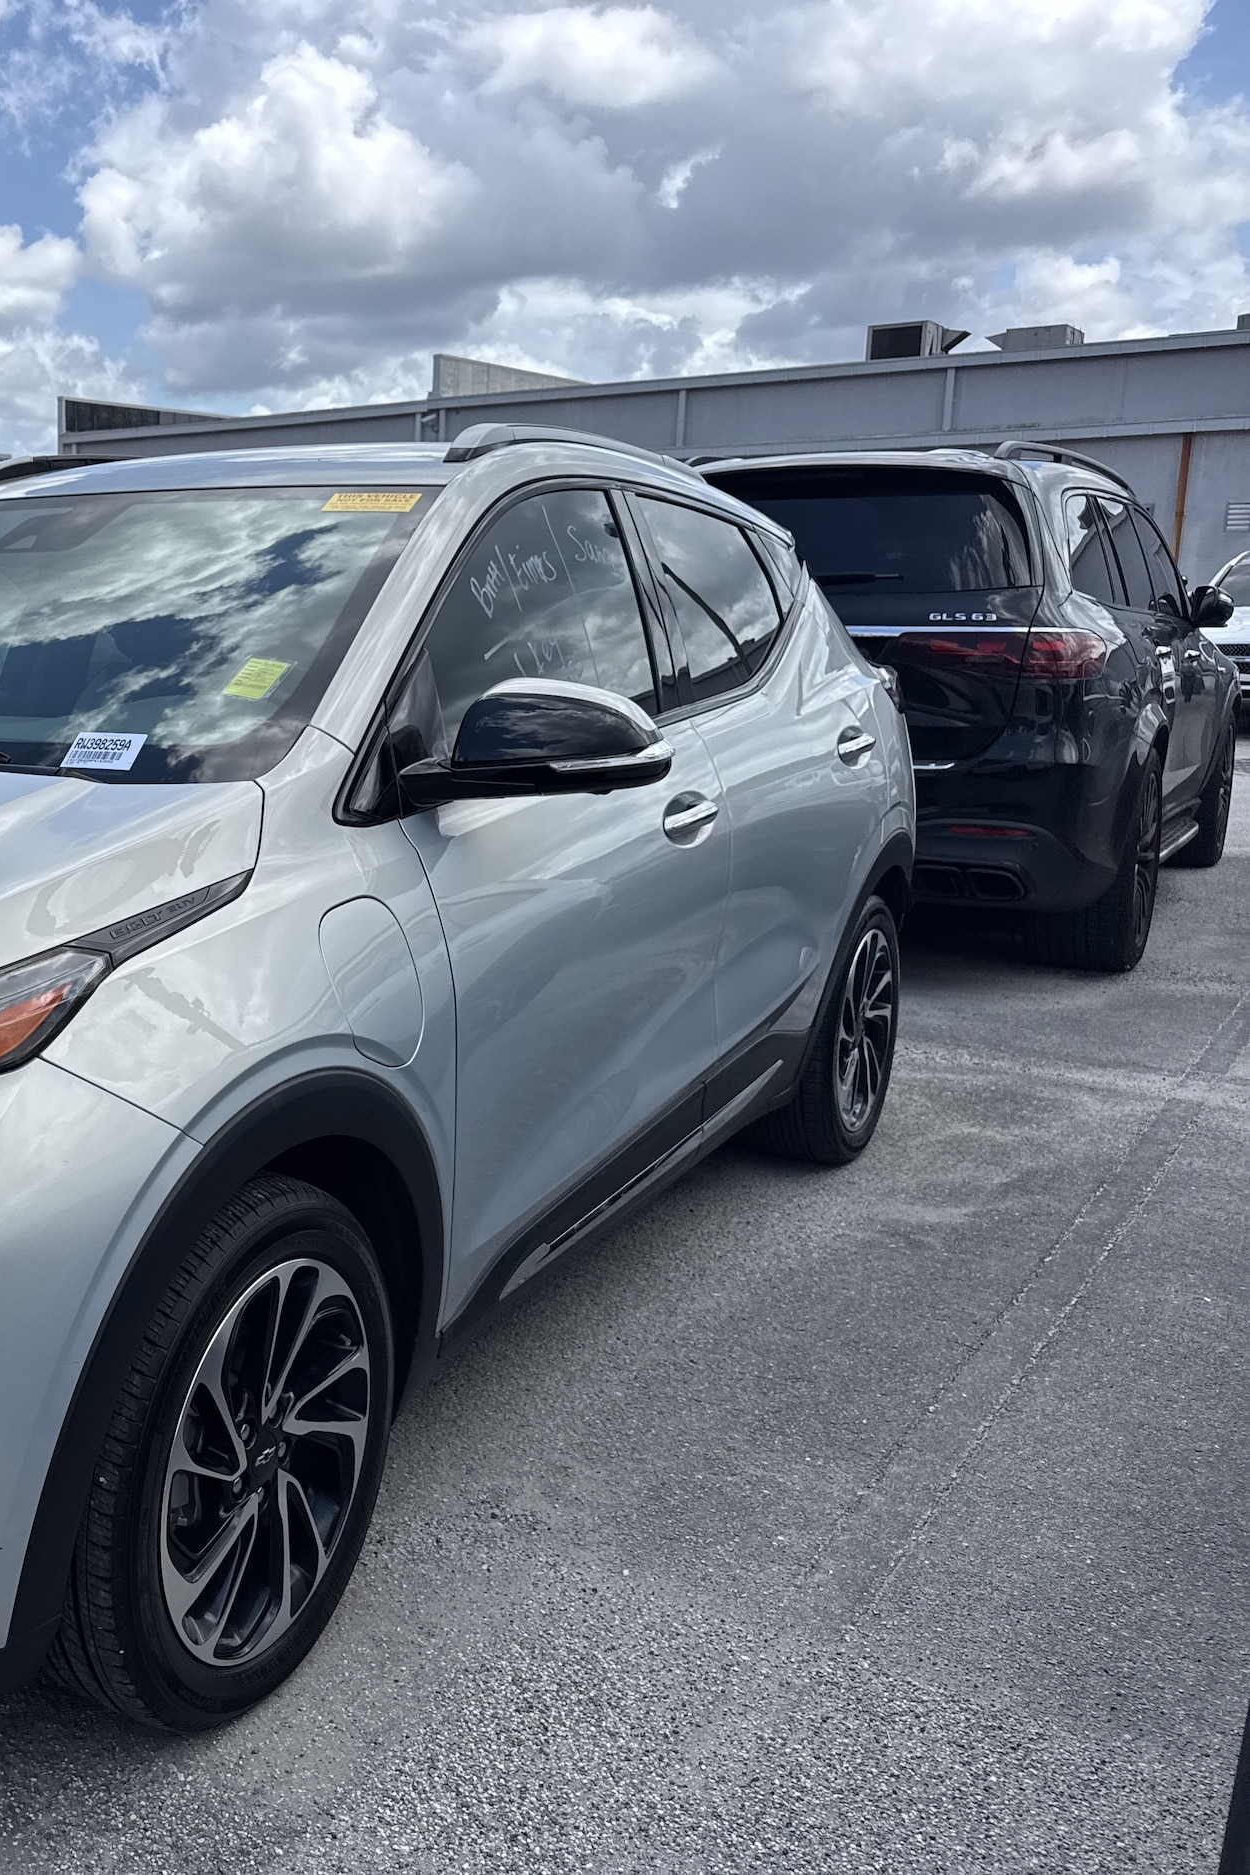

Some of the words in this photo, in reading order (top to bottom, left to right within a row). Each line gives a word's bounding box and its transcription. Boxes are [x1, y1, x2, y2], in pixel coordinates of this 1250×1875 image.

[929, 613, 967, 621] GLS
[971, 613, 997, 621] 63
[73, 736, 131, 752] RW398259A
[109, 908, 163, 940] BOLT
[166, 896, 196, 913] EUV
